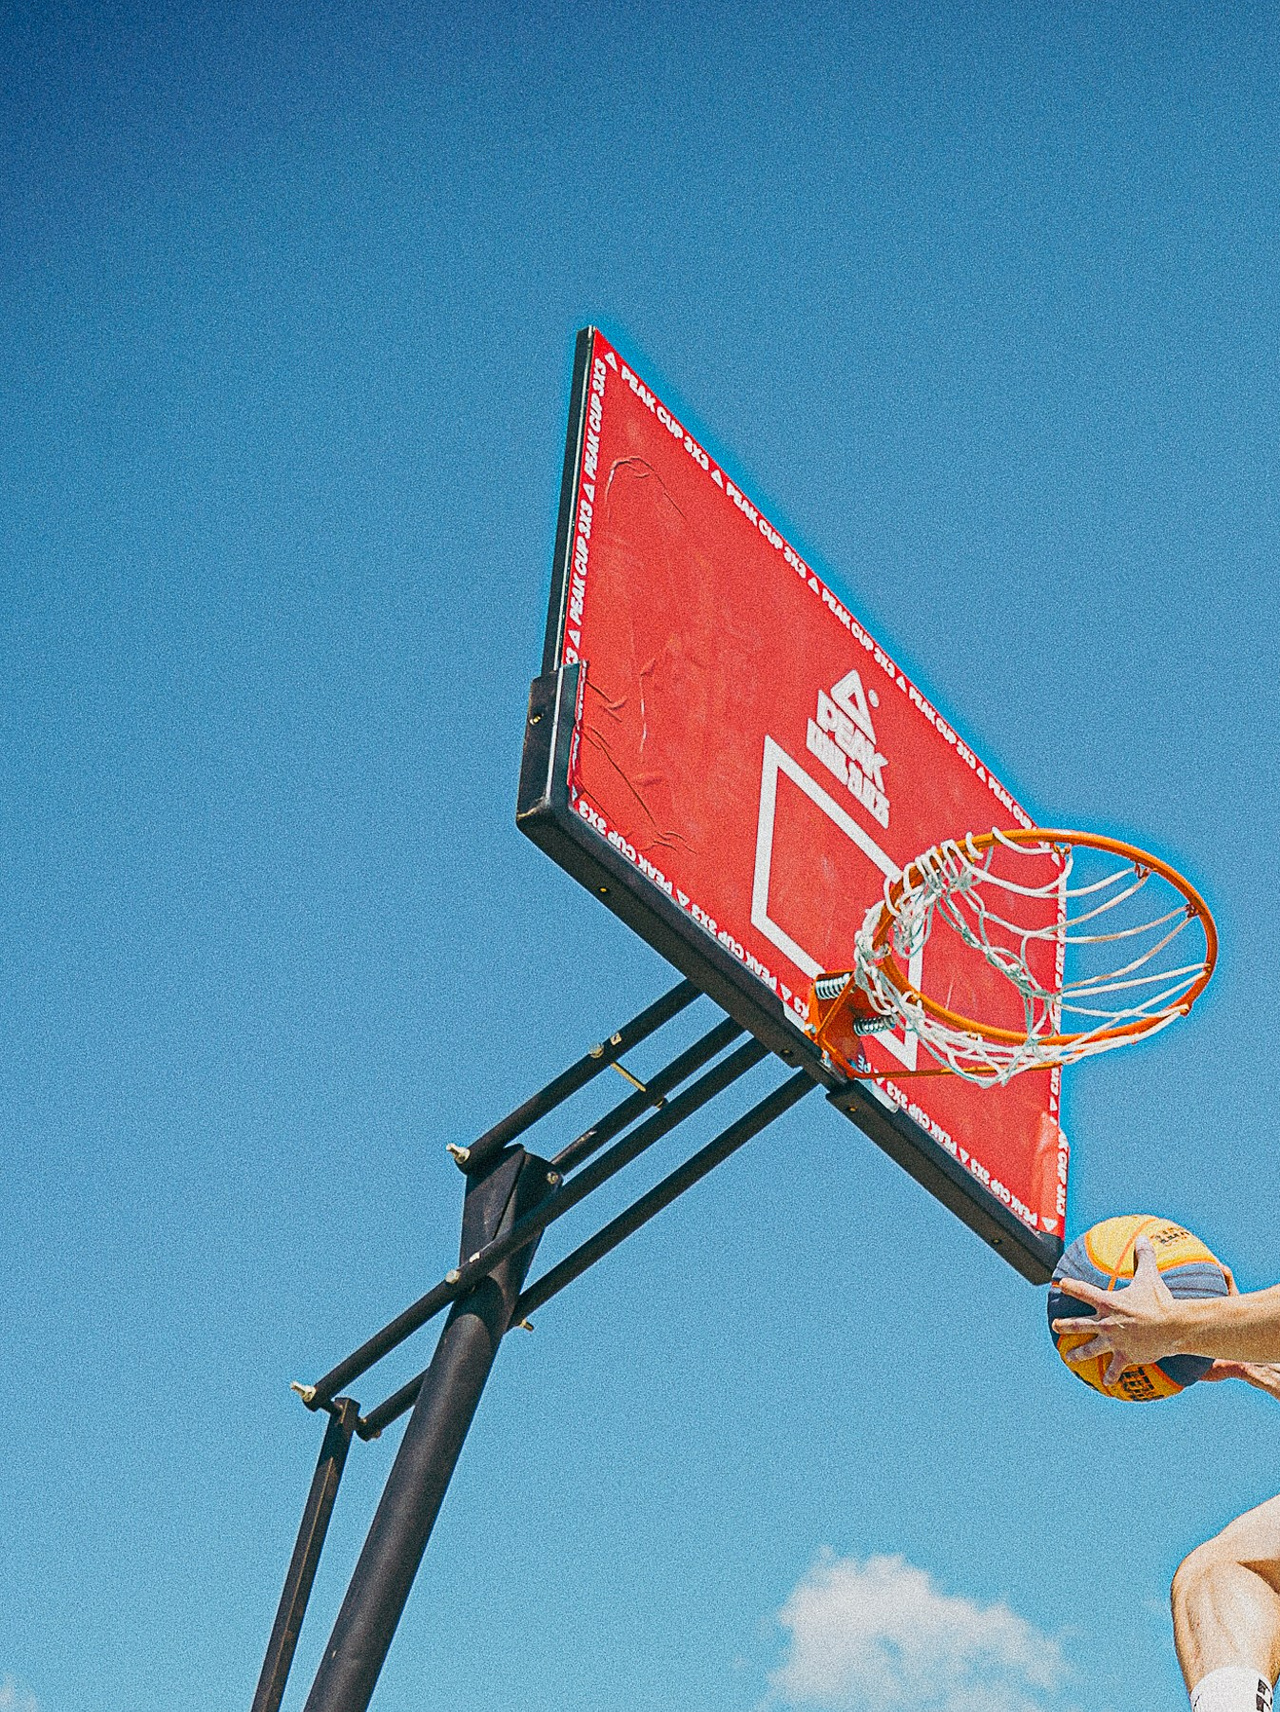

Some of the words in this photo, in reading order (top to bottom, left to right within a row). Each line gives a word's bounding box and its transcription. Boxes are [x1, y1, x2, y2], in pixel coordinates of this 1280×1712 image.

[592, 358, 607, 397] 3X3
[589, 393, 603, 433] CUP
[583, 427, 600, 481] PEAK
[578, 499, 593, 539] 3X3
[621, 365, 656, 413] PEAK
[656, 406, 684, 439] CUP
[726, 482, 758, 526] PEAK
[758, 519, 783, 549] CUP
[822, 588, 851, 629] PEAK
[851, 622, 874, 651] CUP
[574, 535, 589, 576] CUP
[569, 572, 586, 626] PEAK
[816, 688, 889, 795] PEAK
[579, 800, 607, 835] 3X3
[607, 830, 637, 862] CUP
[638, 853, 673, 896] PEAK
[691, 903, 718, 936] 3X3
[718, 931, 744, 960] CUP
[745, 951, 777, 991] PEAK
[908, 1103, 930, 1129] CUP
[930, 1120, 957, 1156] PEAK
[990, 1179, 1011, 1203] CUP
[1010, 1194, 1038, 1226] PEAK
